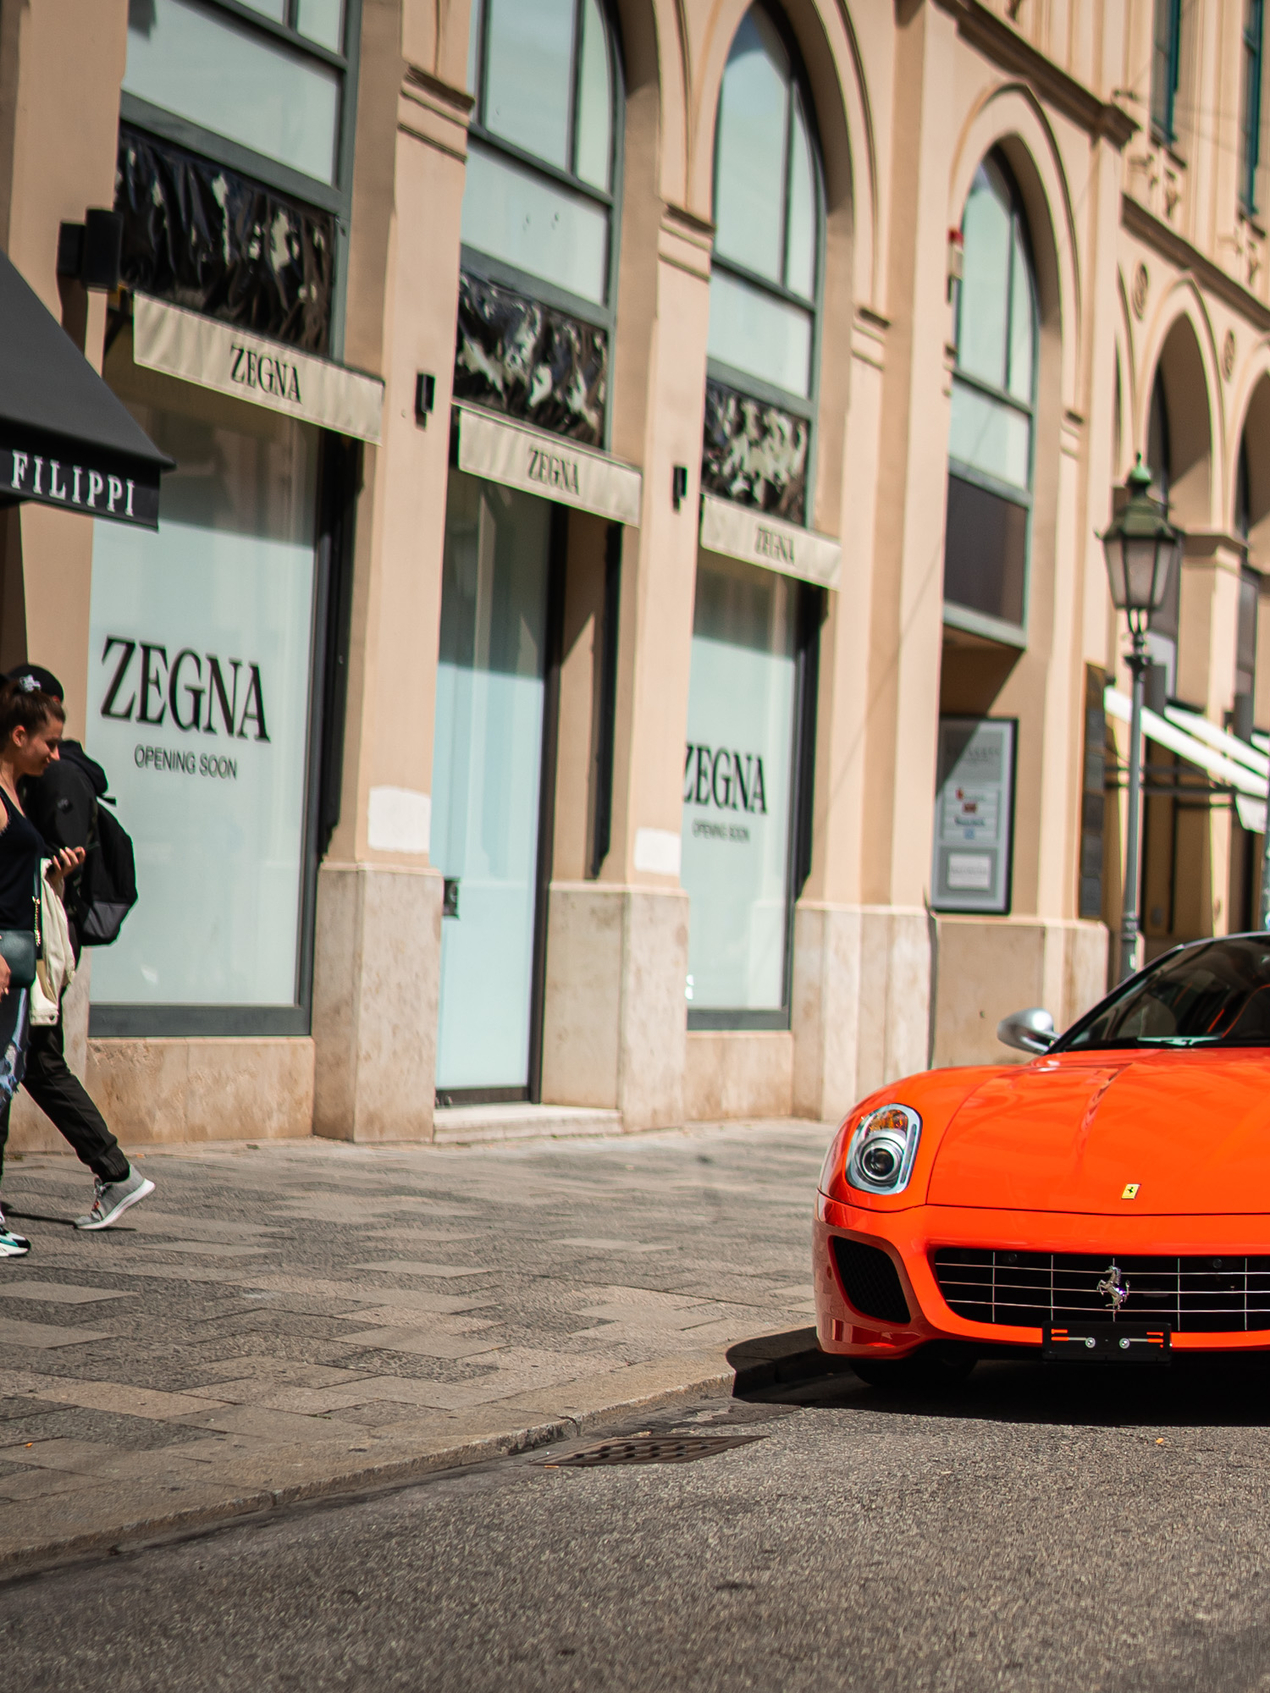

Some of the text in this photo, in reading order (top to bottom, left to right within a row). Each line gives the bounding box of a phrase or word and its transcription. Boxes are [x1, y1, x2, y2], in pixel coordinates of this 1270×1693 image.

[231, 344, 302, 403] ZEGNA
[10, 449, 136, 517] FILIPPI
[527, 445, 580, 496] ZEGNA
[101, 633, 271, 744] ZEGNA
[133, 743, 238, 780] OPENING SOON
[684, 742, 767, 815] ZEGNA
